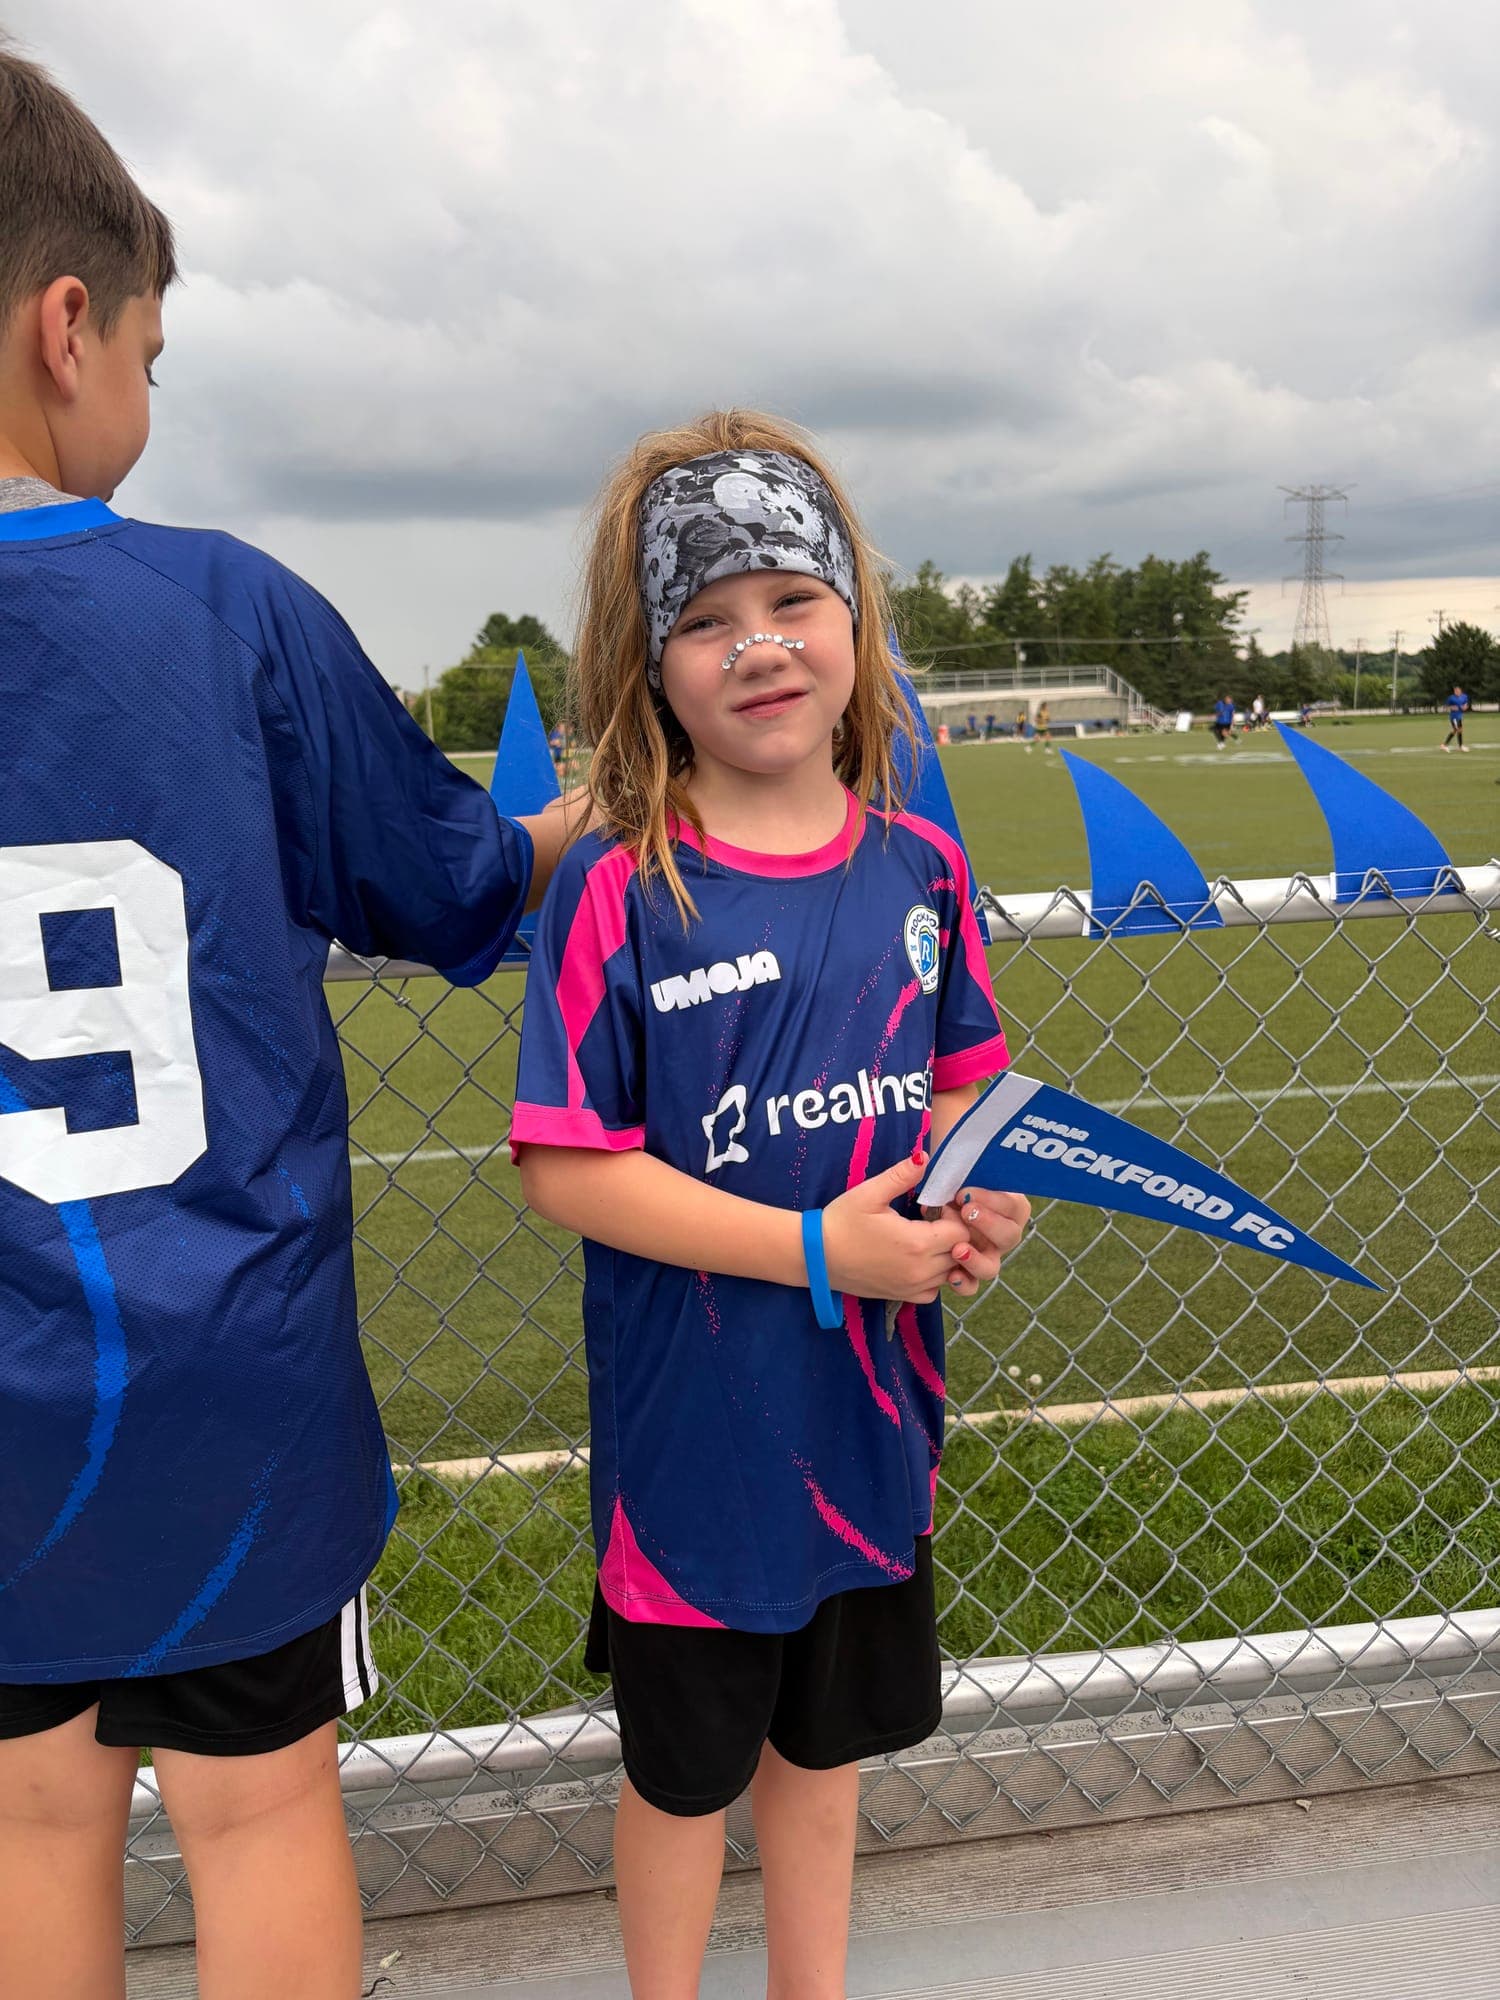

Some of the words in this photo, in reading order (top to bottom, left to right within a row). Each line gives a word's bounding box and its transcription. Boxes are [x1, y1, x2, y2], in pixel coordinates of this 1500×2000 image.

[0, 839, 208, 1204] 9
[650, 951, 781, 1013] UMOJA
[1000, 1127, 1234, 1220] ROCKFORD
[1230, 1212, 1295, 1250] FC
